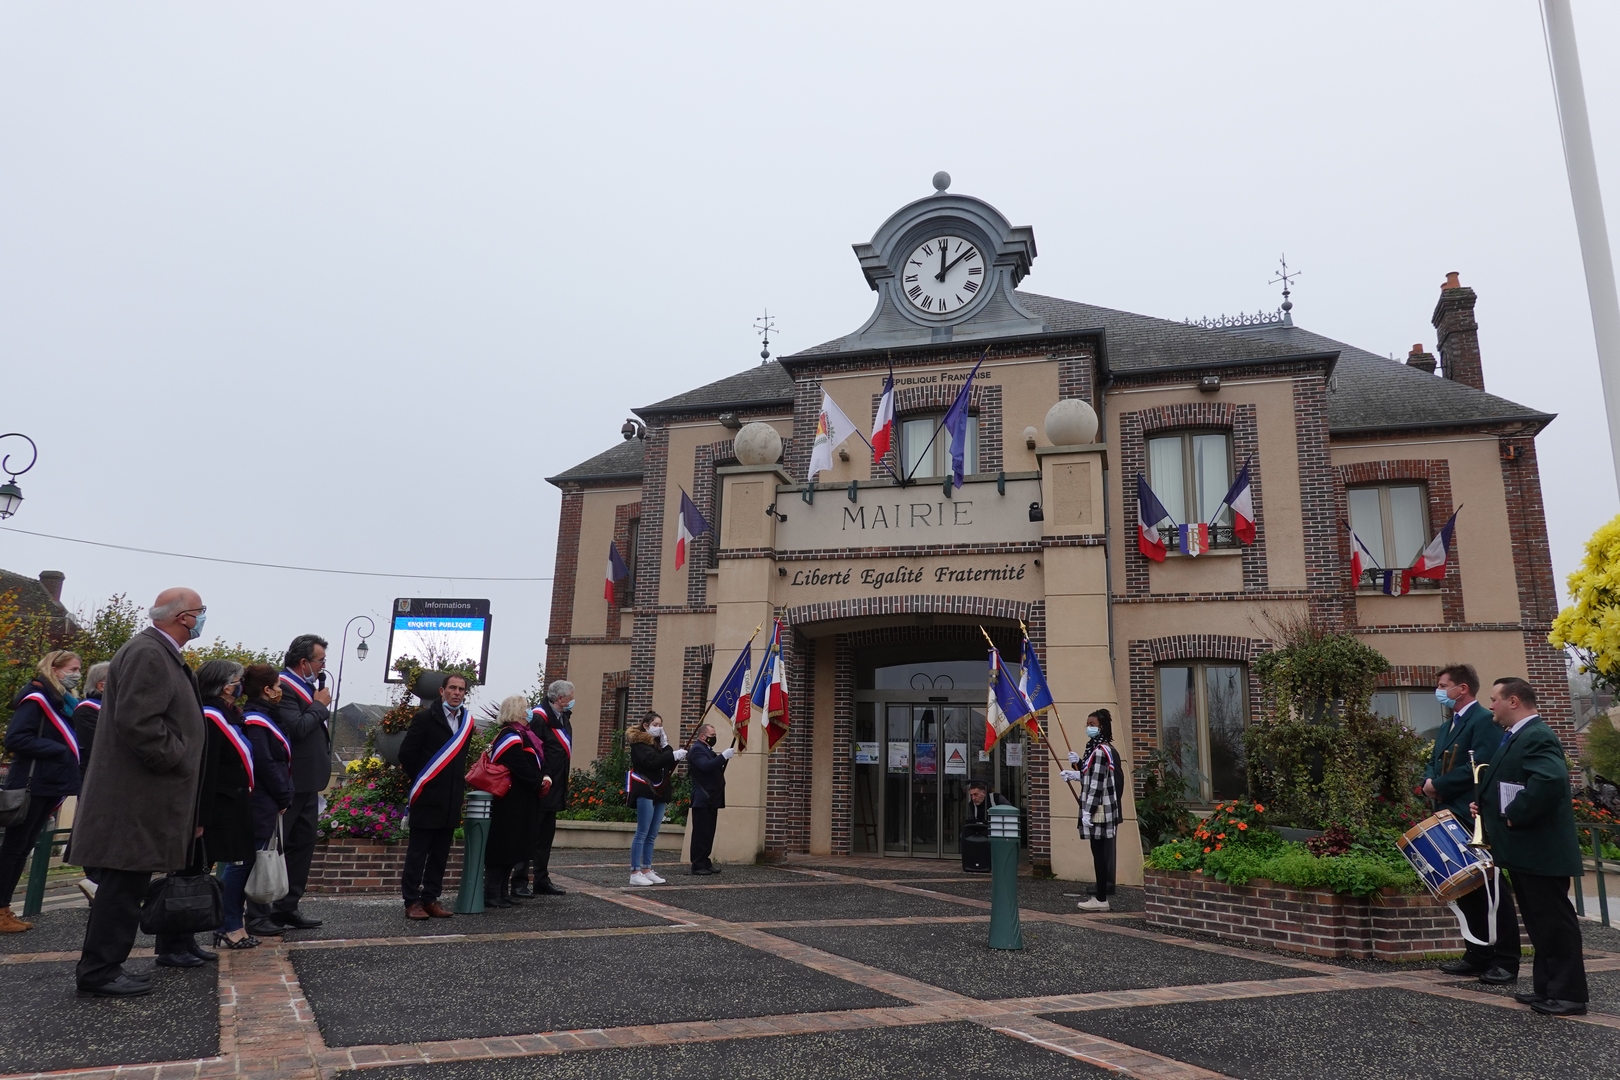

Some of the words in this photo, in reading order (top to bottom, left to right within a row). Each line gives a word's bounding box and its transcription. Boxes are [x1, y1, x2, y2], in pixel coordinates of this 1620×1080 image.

[841, 501, 973, 531] MAIRIE
[790, 567, 852, 586] Liberté
[860, 565, 925, 589] Egalité
[934, 563, 1026, 583] Fraternité
[424, 601, 471, 609] Informations
